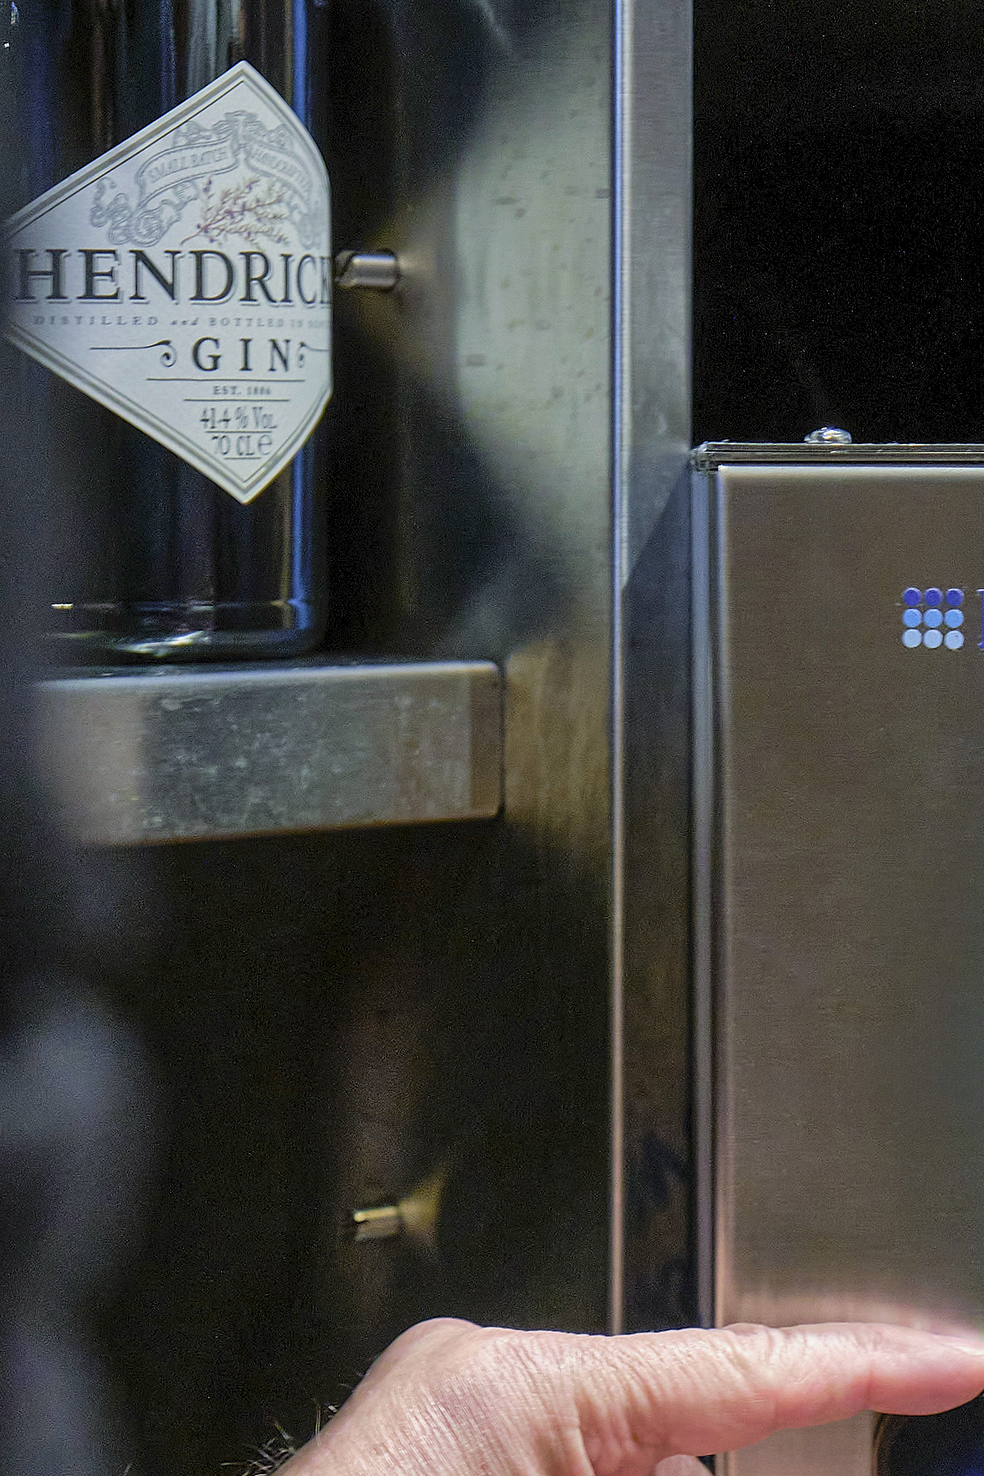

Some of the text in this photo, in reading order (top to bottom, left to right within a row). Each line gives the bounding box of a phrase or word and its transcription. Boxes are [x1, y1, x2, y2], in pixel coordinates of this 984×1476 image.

[32, 315, 159, 326] DISTILLED
[170, 317, 199, 326] and
[208, 317, 285, 328] BOTTLED
[192, 336, 291, 372] GIN
[212, 385, 242, 396] EST.
[210, 434, 231, 456] 70
